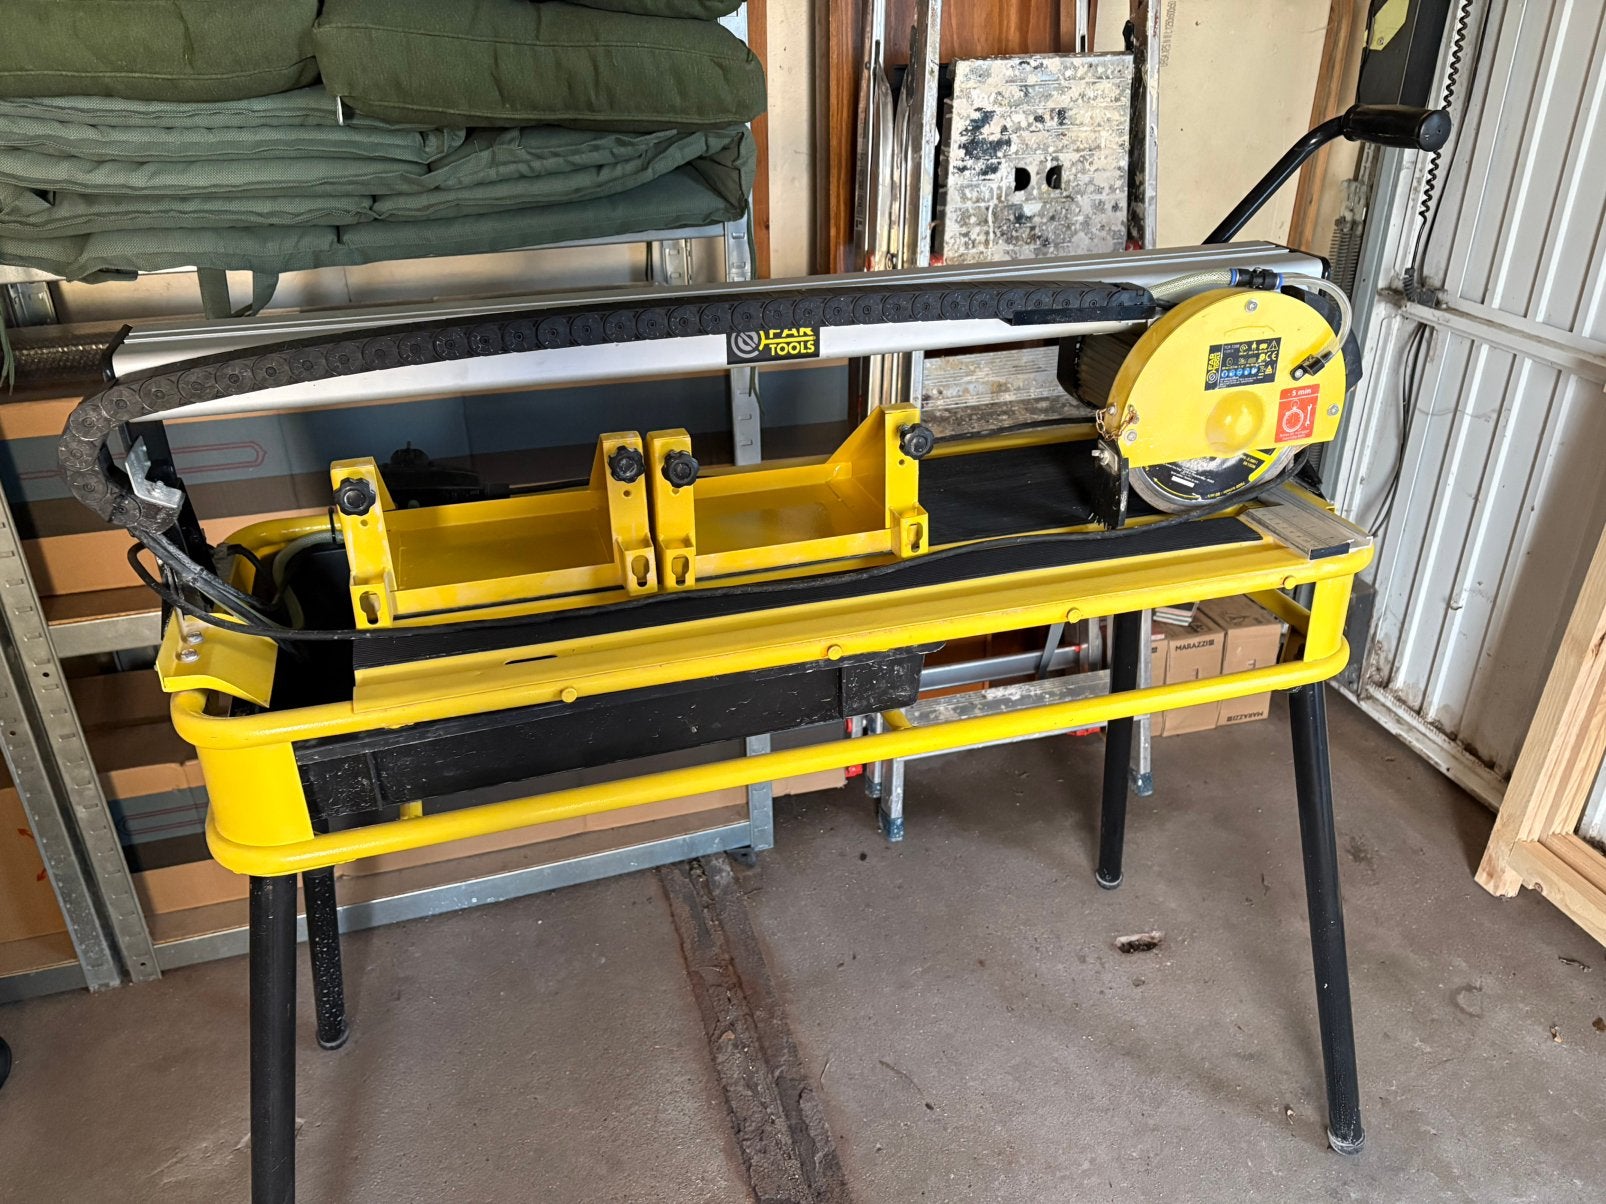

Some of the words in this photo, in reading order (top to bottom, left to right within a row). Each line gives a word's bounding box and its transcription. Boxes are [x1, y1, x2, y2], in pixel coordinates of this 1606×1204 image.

[769, 341, 815, 356] TOOLS
[1175, 640, 1209, 652] MARAZZI
[1232, 711, 1264, 721] MARAZZI
